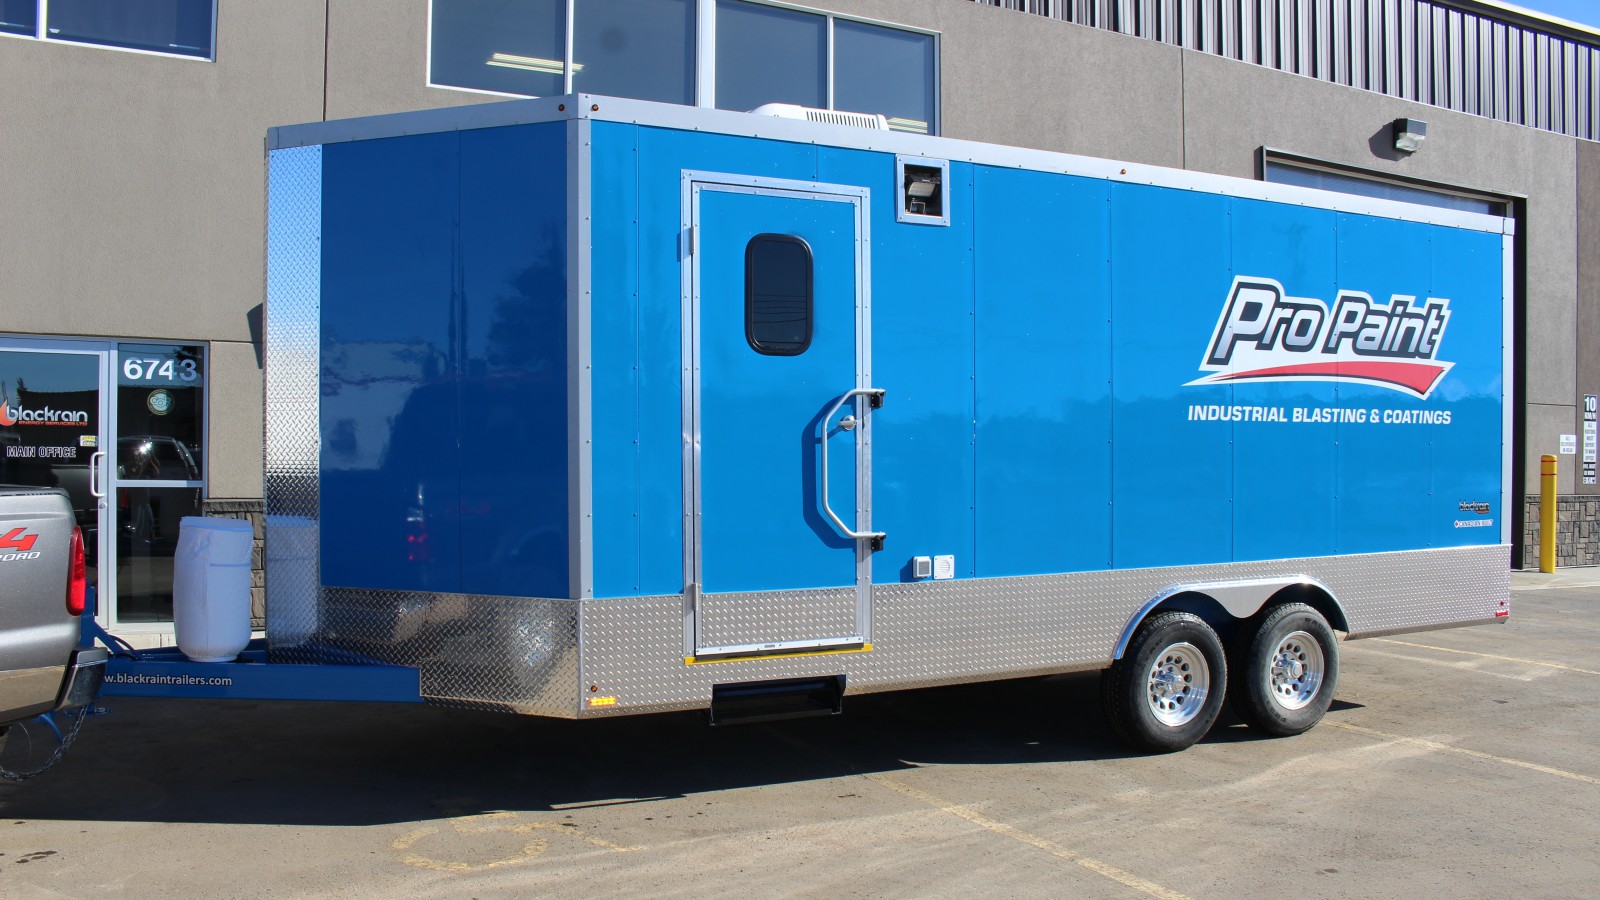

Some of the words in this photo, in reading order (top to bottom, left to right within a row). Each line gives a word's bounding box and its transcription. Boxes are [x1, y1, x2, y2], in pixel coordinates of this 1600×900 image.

[1205, 281, 1323, 366] Pro
[1321, 295, 1447, 360] Paint
[123, 356, 198, 381] 6743
[1584, 396, 1596, 411] 10
[6, 405, 88, 421] blackrain
[1187, 405, 1288, 422] INDUSTRIAL
[1292, 407, 1367, 424] BLASTING
[1369, 409, 1380, 424] &
[1383, 409, 1452, 425] COATINGS
[6, 446, 36, 458] MAIN
[38, 446, 77, 458] OFFICE
